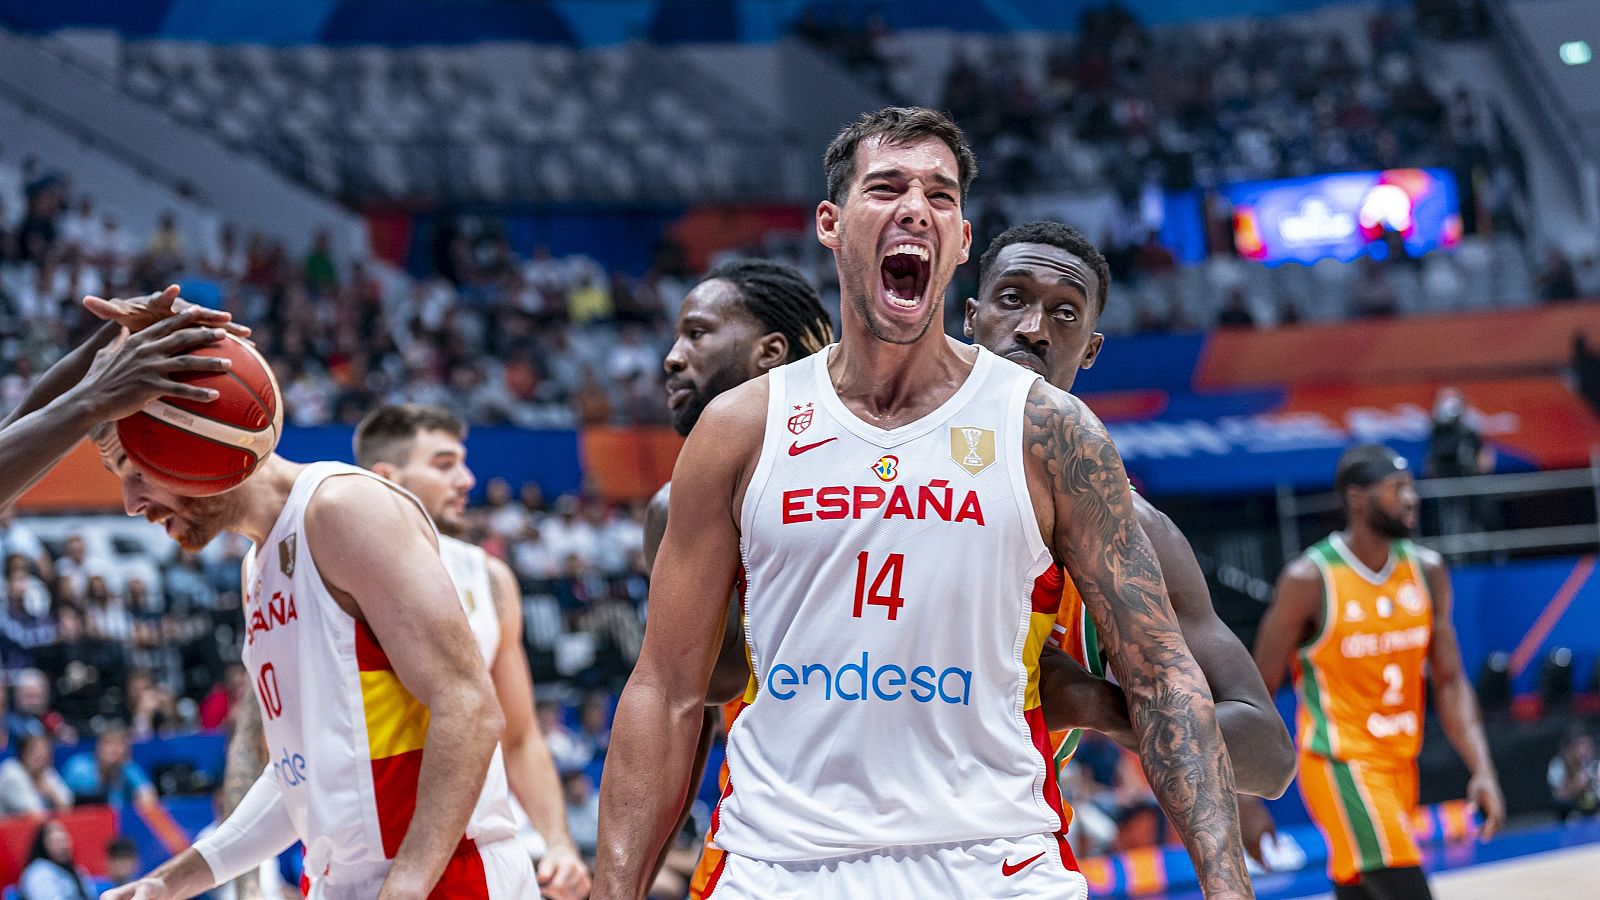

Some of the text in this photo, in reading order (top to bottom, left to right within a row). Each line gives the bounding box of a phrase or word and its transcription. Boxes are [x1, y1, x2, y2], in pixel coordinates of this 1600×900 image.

[782, 479, 985, 526] ESPAÑA
[852, 551, 905, 620] 14
[256, 661, 282, 720] 10
[767, 651, 973, 706] endesa
[1382, 663, 1404, 706] 2
